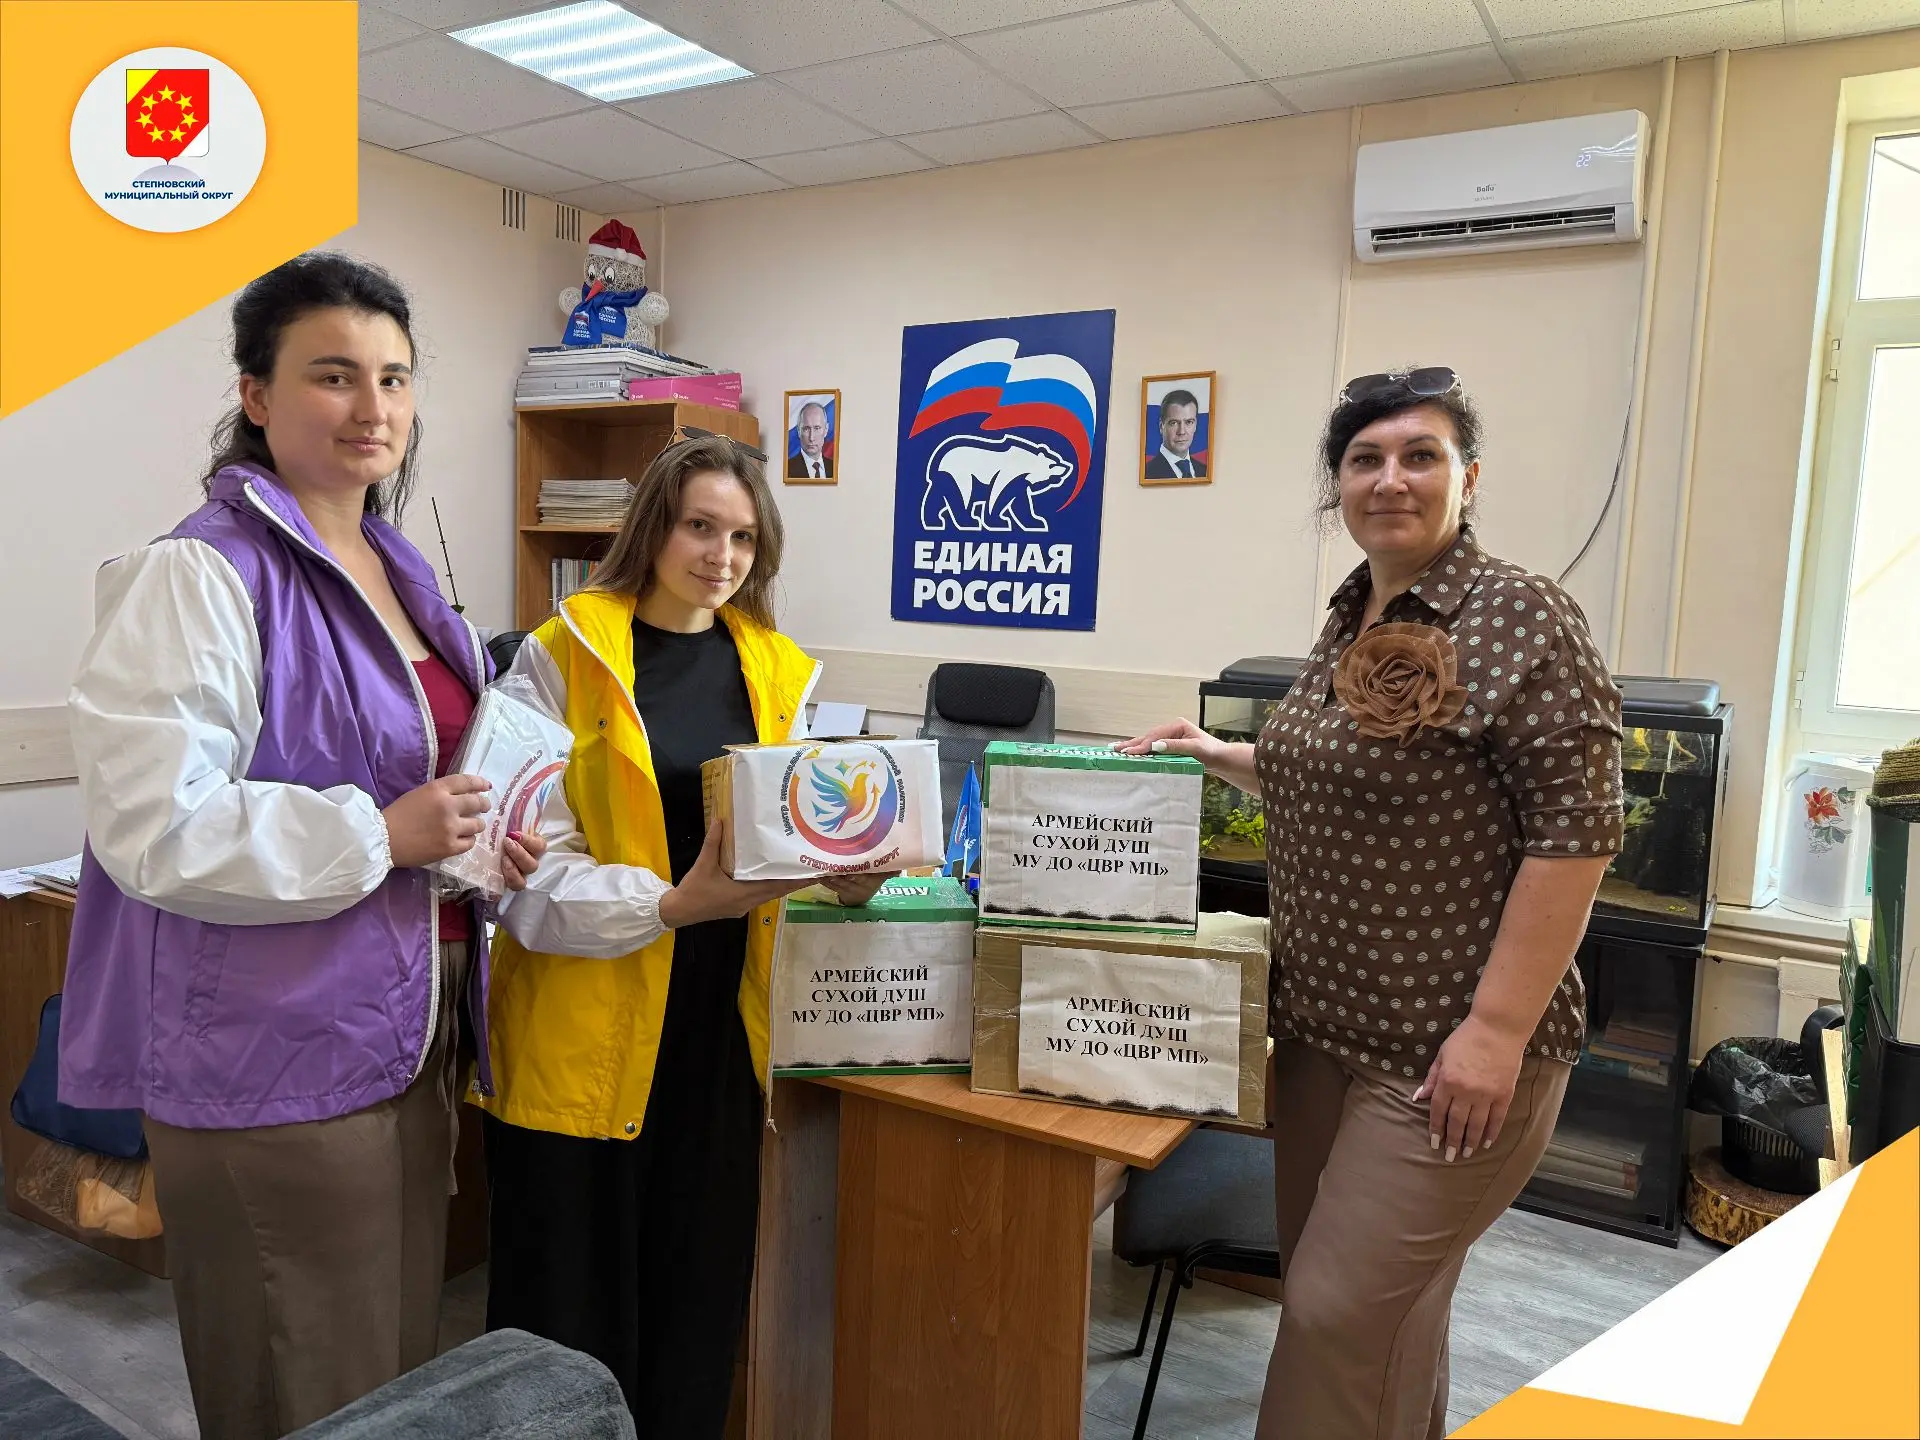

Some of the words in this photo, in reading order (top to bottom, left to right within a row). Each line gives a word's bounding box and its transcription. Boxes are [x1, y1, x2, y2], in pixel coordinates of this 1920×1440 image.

[1576, 154, 1592, 168] 22
[914, 540, 1073, 575] ЕДИНАЯ
[913, 578, 1071, 616] РОССИЯ
[1032, 813, 1153, 834] АРМЕЙСКИЙ
[1032, 834, 1099, 851] СУХОЙ
[1103, 839, 1150, 855] ДУШ
[1012, 853, 1043, 869] МУ
[1045, 856, 1073, 872] ДО
[1077, 857, 1125, 875] «ЦВР
[1129, 860, 1169, 876] МП»
[810, 964, 929, 983] АРМЕЙСКИЙ
[811, 986, 878, 1003] СУХОЙ
[882, 988, 926, 1005] ДУШ
[792, 1010, 822, 1024] МУ
[825, 1010, 852, 1026] ДО
[856, 1009, 902, 1024] «ЦВР
[906, 1007, 945, 1022] МП»
[1065, 996, 1192, 1022] АРМЕЙСКИЙ
[1066, 1017, 1136, 1036] СУХОЙ
[1140, 1025, 1188, 1043] ДУШ
[1045, 1036, 1077, 1053] МУ
[1081, 1041, 1109, 1057] ДО
[1113, 1043, 1162, 1062] «ЦВР
[1166, 1046, 1210, 1066] МП»
